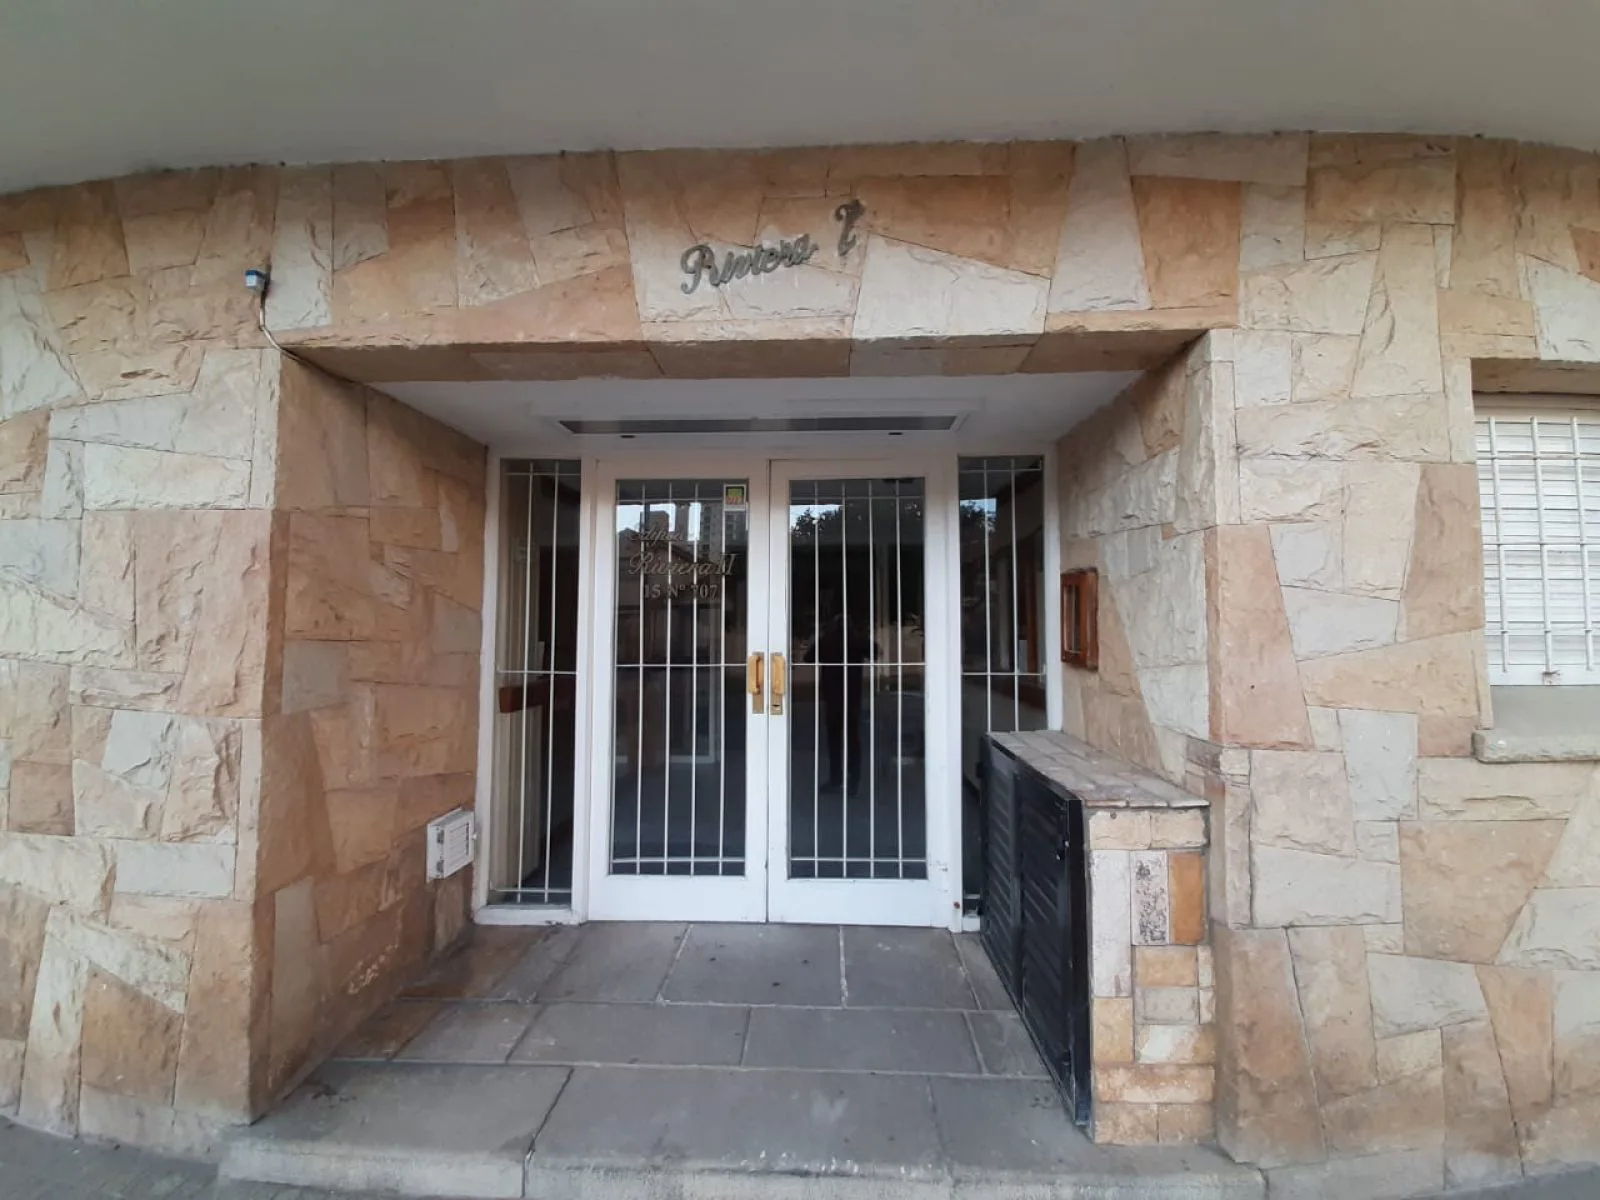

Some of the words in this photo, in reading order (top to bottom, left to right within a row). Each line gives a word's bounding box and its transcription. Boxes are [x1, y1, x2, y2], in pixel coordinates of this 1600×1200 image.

[680, 233, 820, 294] Riviera
[628, 551, 714, 575] Riviera
[691, 584, 718, 599] 707
